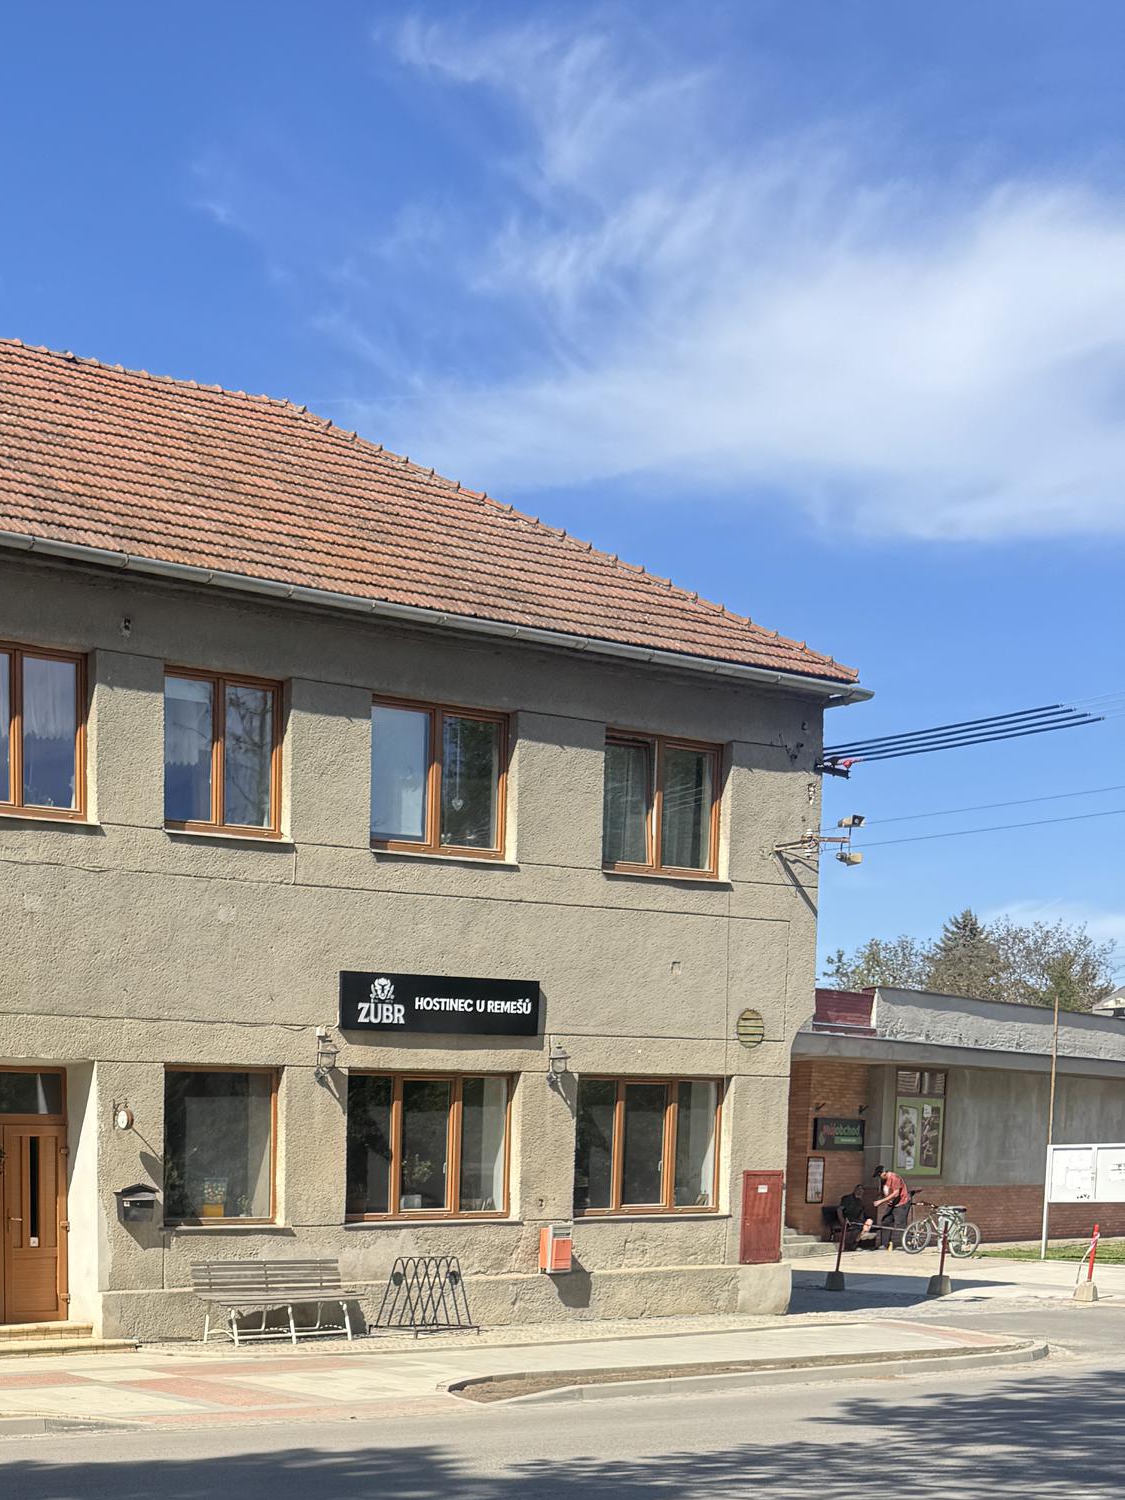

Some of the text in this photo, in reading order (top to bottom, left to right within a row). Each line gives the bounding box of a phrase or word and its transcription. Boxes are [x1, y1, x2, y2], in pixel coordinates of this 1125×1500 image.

[357, 1002, 406, 1024] ZUBR
[415, 997, 532, 1015] HOSTINEC U REMEŠŮ
